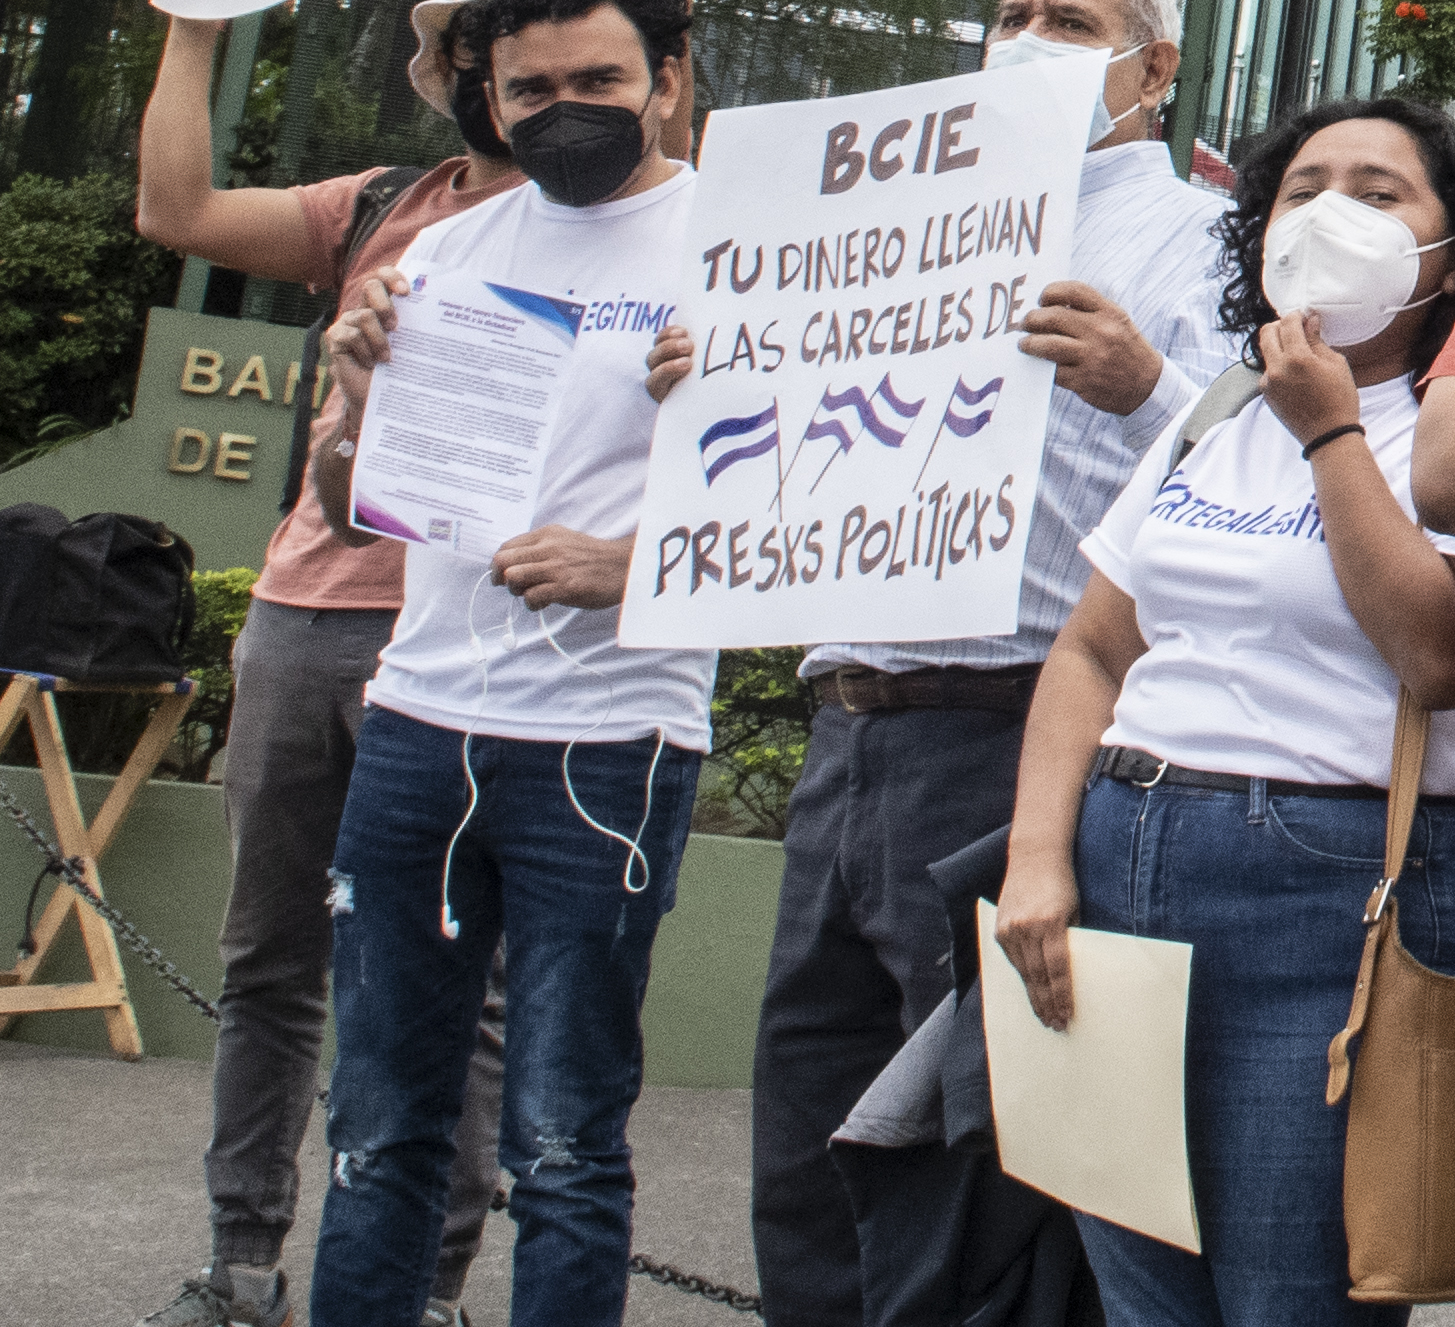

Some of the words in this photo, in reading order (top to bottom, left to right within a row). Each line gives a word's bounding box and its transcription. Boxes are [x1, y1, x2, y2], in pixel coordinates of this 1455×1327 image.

[820, 102, 980, 196] BCIE
[702, 238, 764, 294] TU
[777, 226, 907, 293] DINERO
[919, 192, 1048, 276] LLENAN
[700, 319, 785, 380] LAS
[800, 286, 974, 367] CARCELES
[983, 273, 1029, 339] DE
[168, 426, 257, 481] DE
[653, 515, 824, 598] PRESXS
